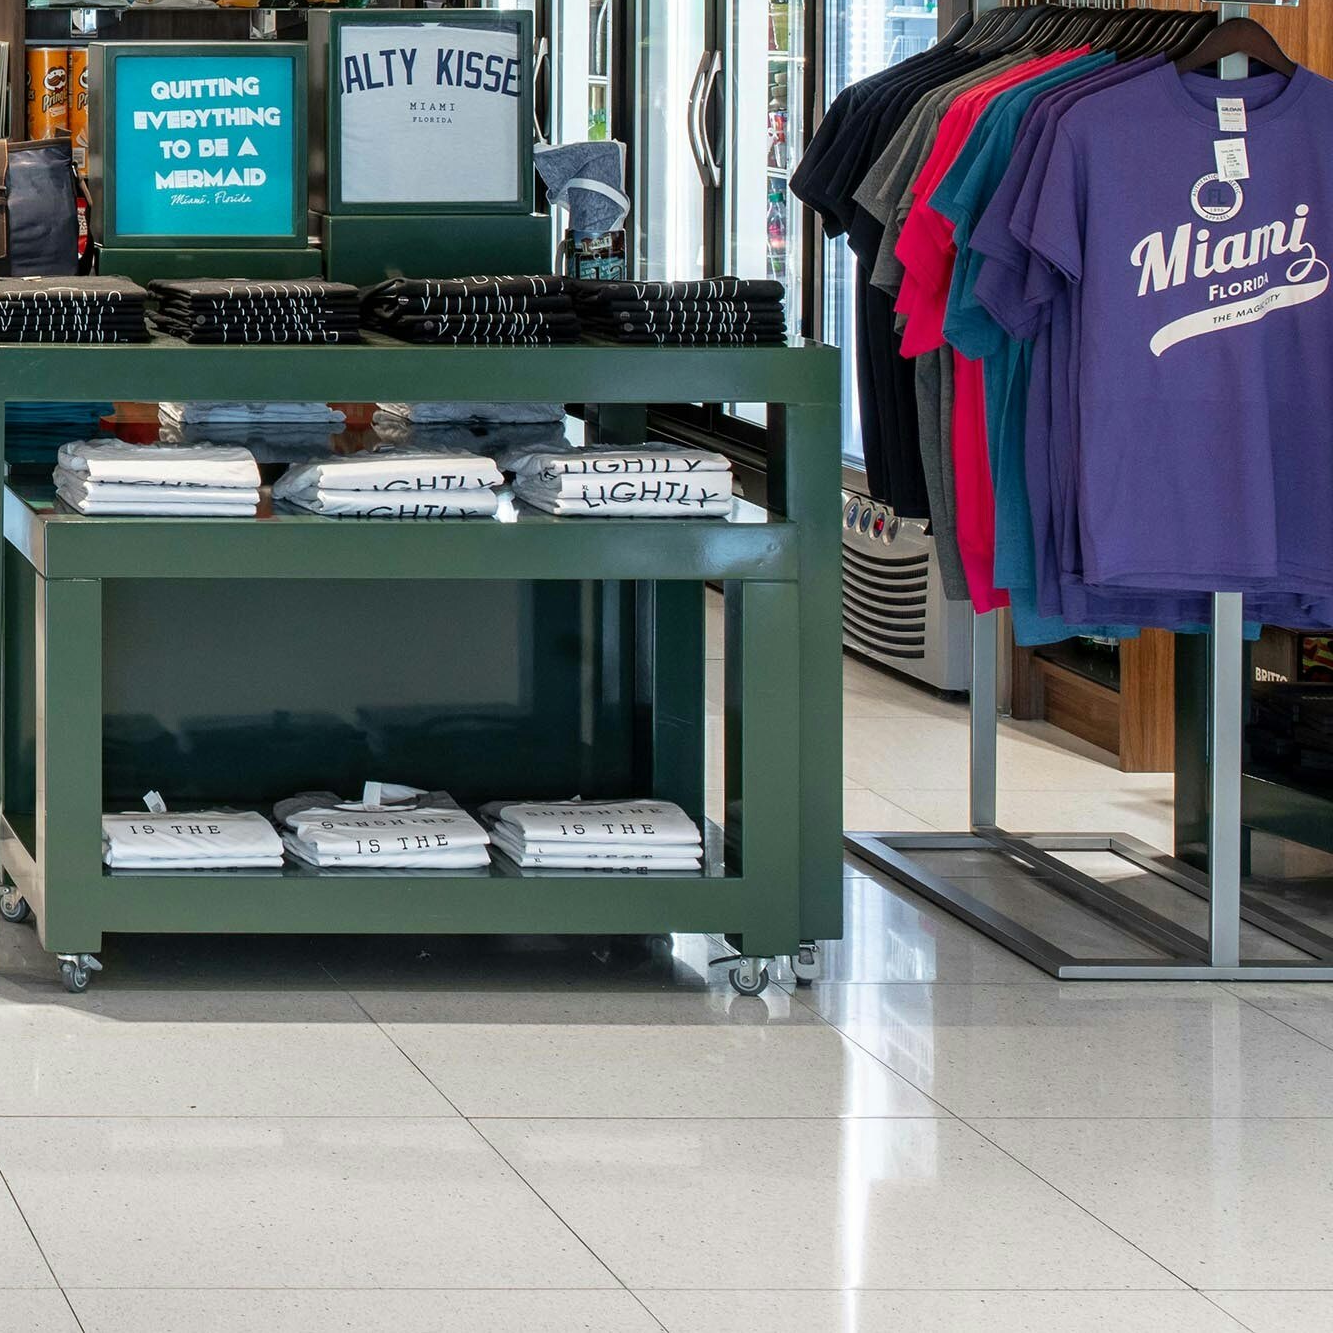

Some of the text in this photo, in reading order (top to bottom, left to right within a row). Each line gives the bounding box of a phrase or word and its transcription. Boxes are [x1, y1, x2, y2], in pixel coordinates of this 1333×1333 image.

[337, 48, 521, 97] ALTY KISSE
[151, 76, 259, 100] QUITTING
[409, 102, 457, 111] MIAMI
[133, 107, 281, 130] EVERYTHING
[159, 136, 259, 159] TO BE A
[155, 168, 267, 190] MERMAID
[215, 191, 253, 204] Florida
[1130, 204, 1310, 297] Miami
[1209, 272, 1269, 301] FLORIDA
[1213, 313, 1231, 324] THE
[583, 481, 719, 508] LIGHTLY
[130, 825, 221, 836] IS THE
[561, 823, 655, 836] IS THE
[356, 834, 449, 854] IS THE
